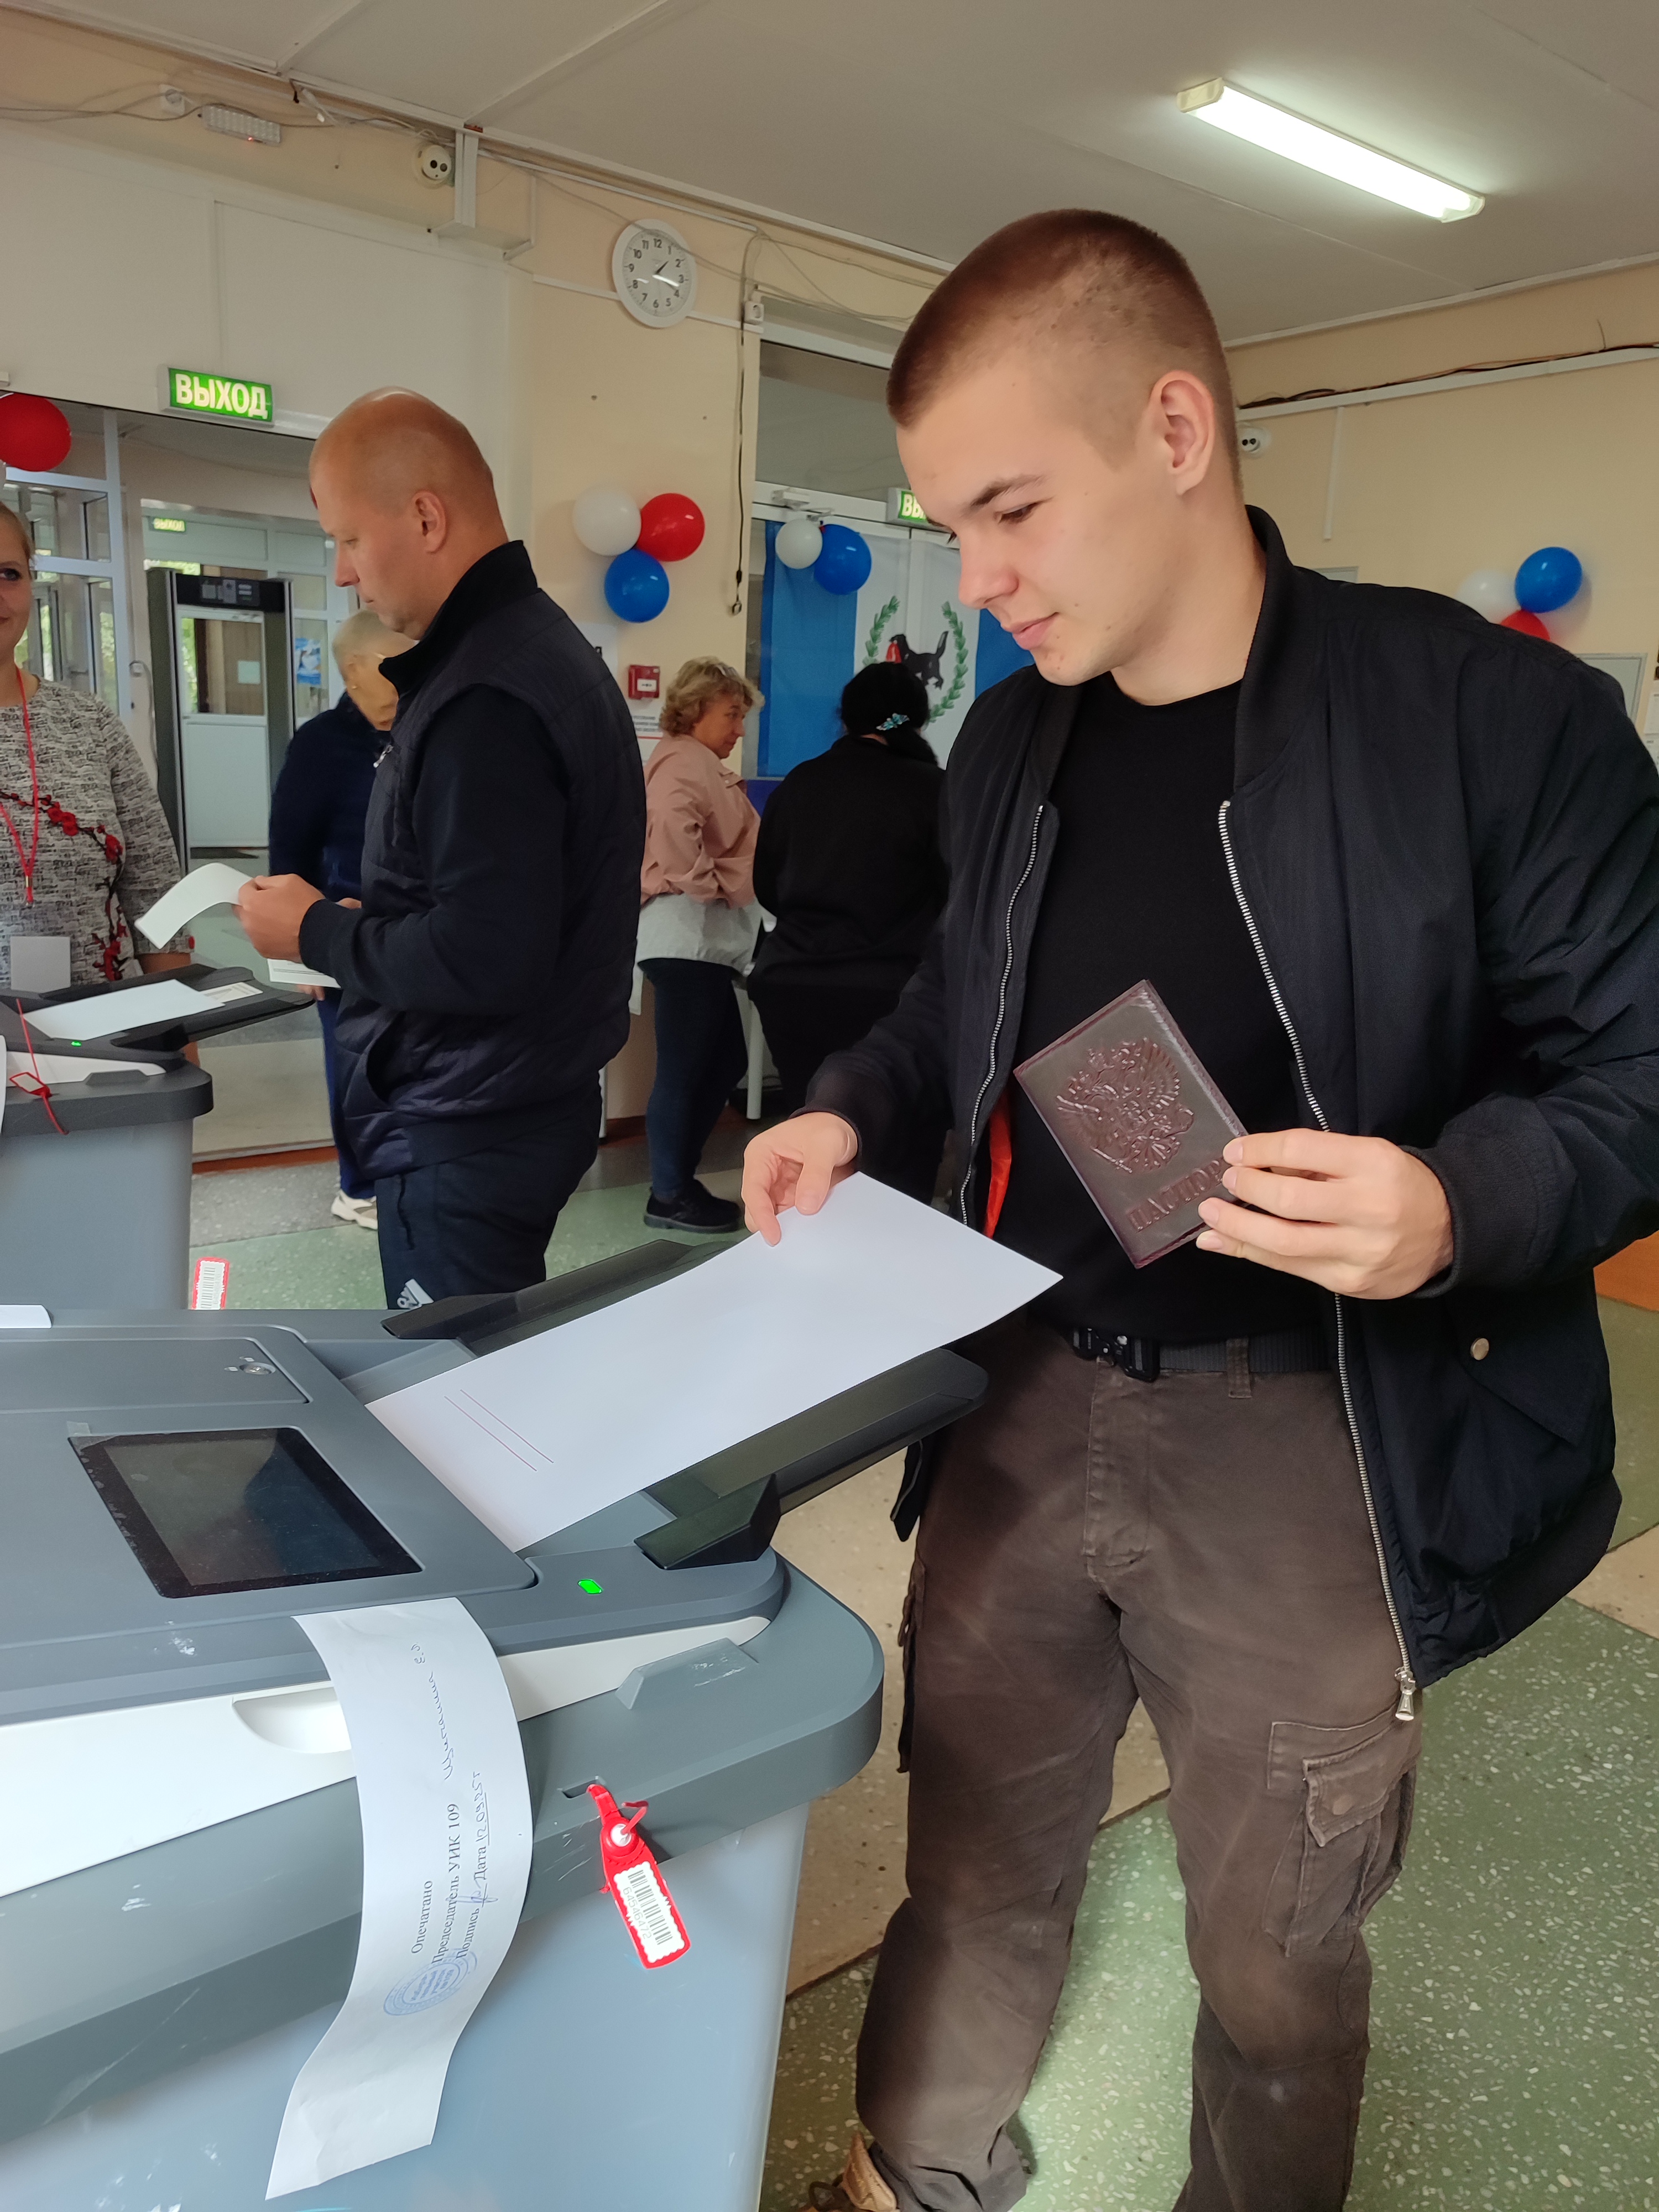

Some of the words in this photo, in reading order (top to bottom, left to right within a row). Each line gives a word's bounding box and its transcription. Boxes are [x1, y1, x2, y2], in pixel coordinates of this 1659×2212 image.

[642, 239, 649, 250] 11
[653, 238, 662, 249] 12
[633, 248, 643, 259] 10
[667, 245, 672, 255] 1
[629, 263, 635, 273] 9
[675, 258, 681, 268] 2
[633, 279, 639, 289] 8
[679, 274, 684, 284] 3
[642, 293, 648, 301] 7
[674, 289, 680, 298] 4
[653, 299, 659, 308] 6
[665, 298, 671, 307] 5
[175, 373, 268, 419] ВЫХОД
[1126, 1156, 1225, 1233] ПАСПОР
[447, 1804, 460, 1829] 109
[448, 1834, 461, 1874] УИК
[455, 1908, 480, 1959] Подпись
[473, 1845, 488, 1881] Дата
[411, 1880, 433, 1954] Опечатано
[623, 1886, 652, 1939] 64546472
[431, 1875, 460, 1964] Председатель
